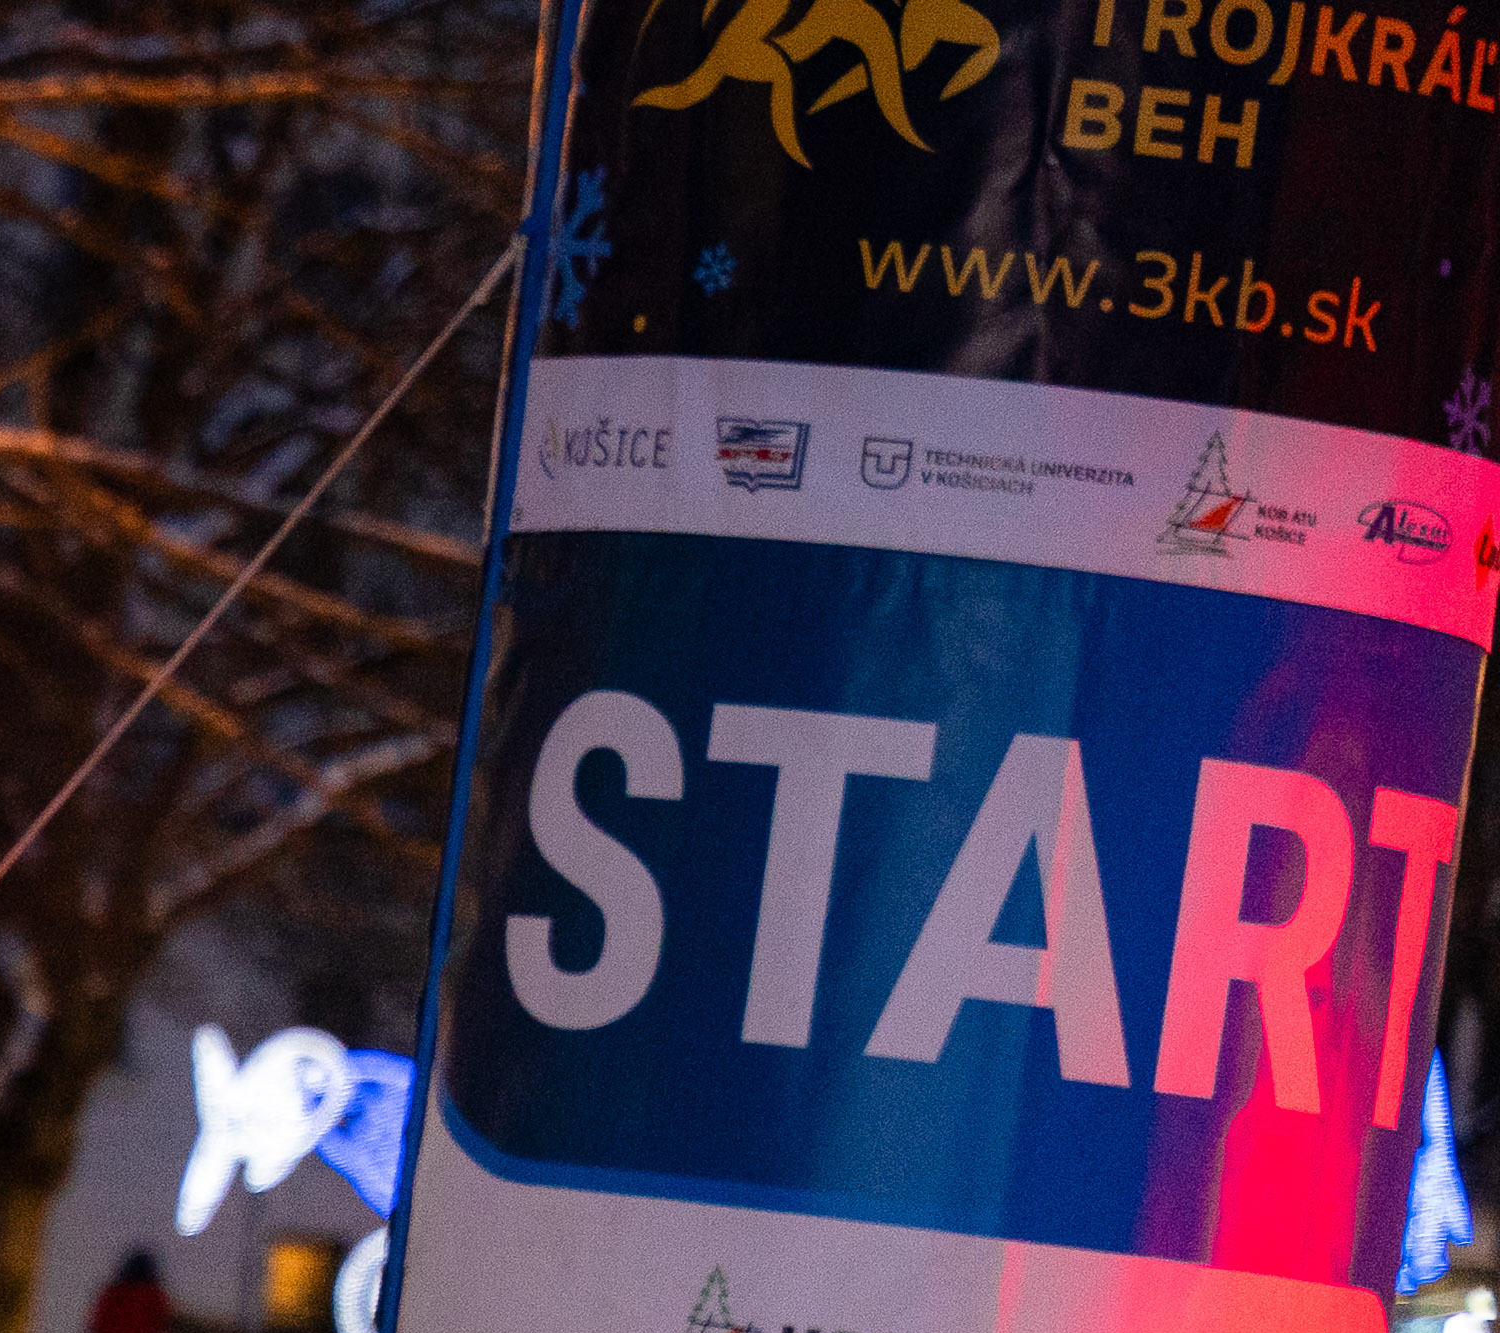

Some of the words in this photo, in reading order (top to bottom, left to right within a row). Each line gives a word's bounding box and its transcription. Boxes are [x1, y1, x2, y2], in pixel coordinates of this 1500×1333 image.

[1063, 78, 1259, 168] BEH
[859, 239, 1382, 352] www.3kb.sk
[921, 471, 933, 484] V
[936, 471, 1034, 496] KOŠICIACH
[925, 449, 1027, 474] TECHNICKÁ
[1031, 461, 1135, 486] UNIVERZITA
[504, 689, 1458, 1132] START
